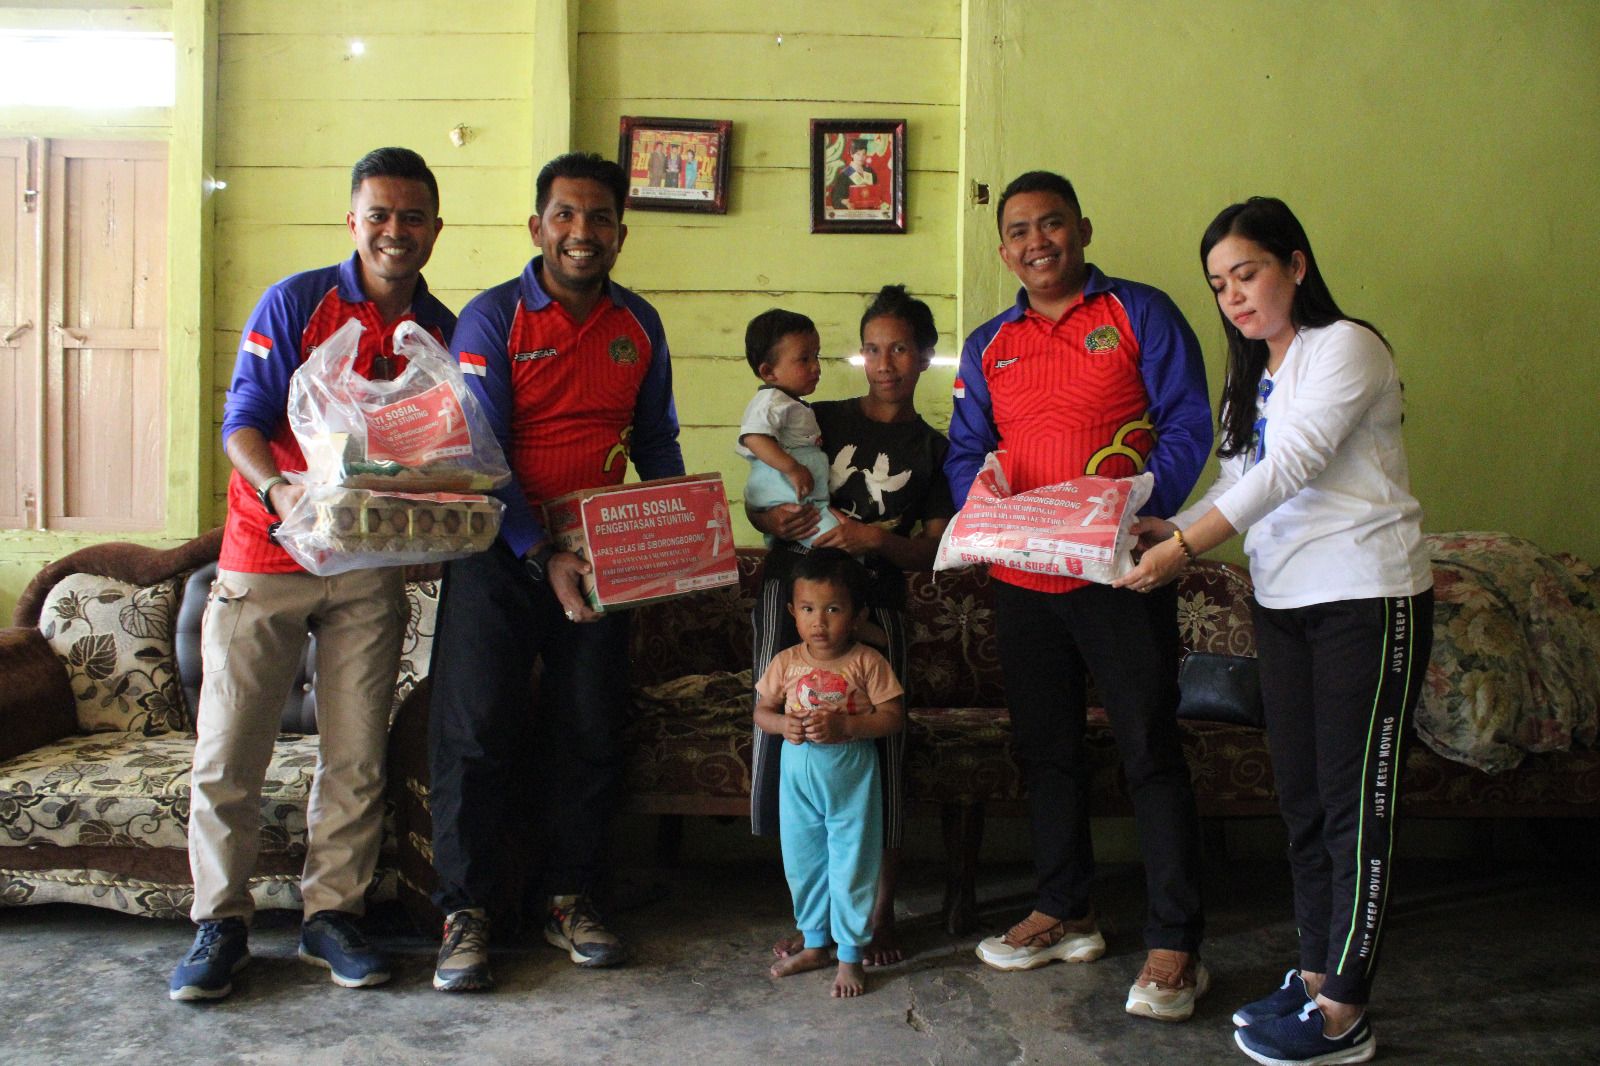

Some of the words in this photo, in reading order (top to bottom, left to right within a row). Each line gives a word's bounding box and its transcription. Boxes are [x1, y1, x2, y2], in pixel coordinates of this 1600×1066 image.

[385, 403, 420, 421] SOSIAL
[399, 409, 430, 425] STUNTING
[600, 503, 640, 522] BAKTI
[642, 498, 686, 516] SOSIAL
[595, 519, 656, 536] PENGENTASAN
[656, 511, 697, 528] STUNTING
[614, 543, 637, 555] KELAS
[647, 533, 706, 550] SIBORONGBORONG
[1024, 561, 1061, 574] SUPER
[1395, 611, 1406, 640] KEEP
[1392, 646, 1404, 673] JUST
[1379, 716, 1395, 757] MOVING
[1376, 760, 1388, 787] KEEP
[1375, 792, 1387, 818] JUST
[1369, 858, 1382, 900] MOVING
[1366, 901, 1378, 929] KEEP
